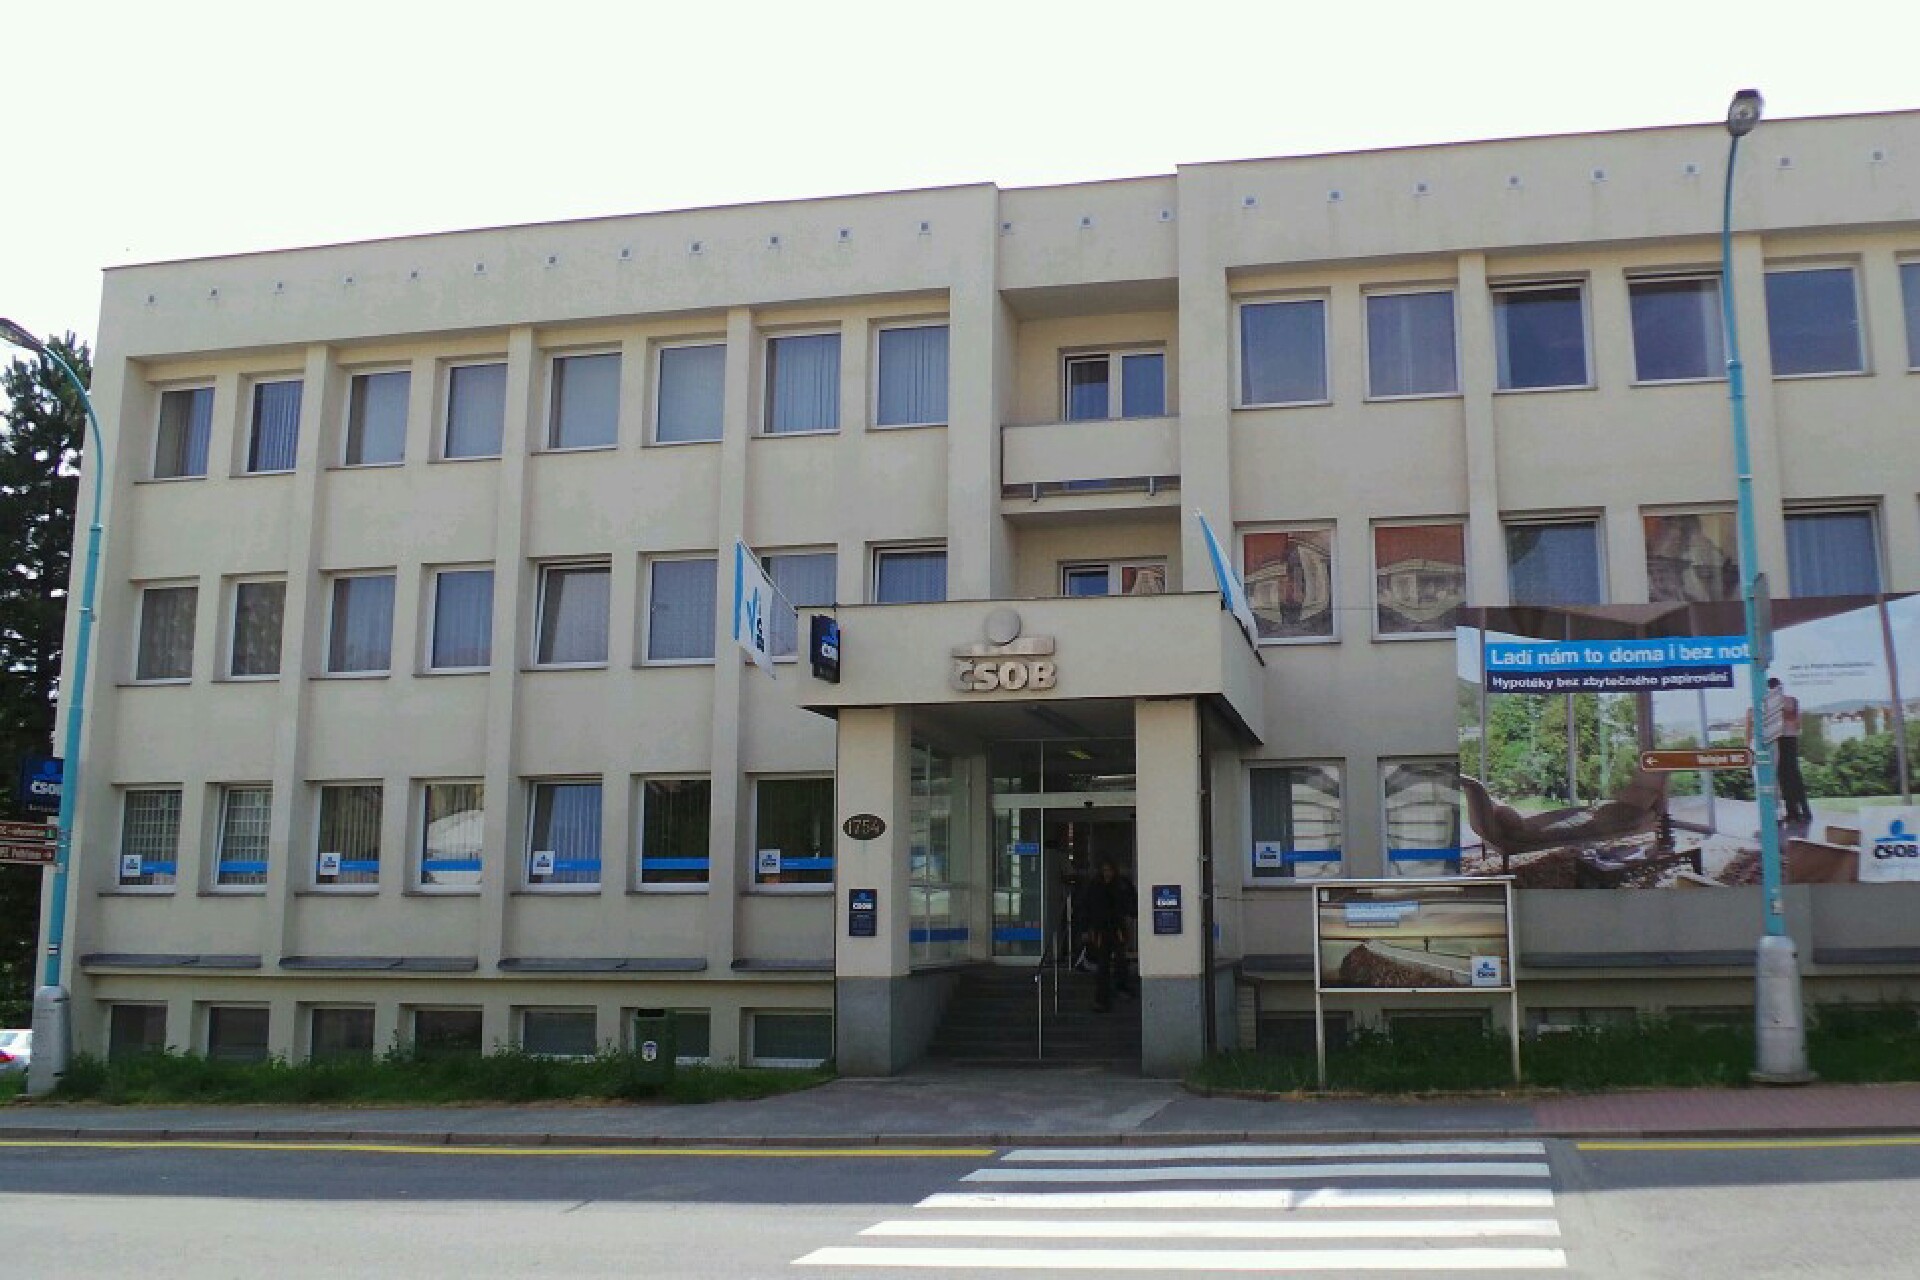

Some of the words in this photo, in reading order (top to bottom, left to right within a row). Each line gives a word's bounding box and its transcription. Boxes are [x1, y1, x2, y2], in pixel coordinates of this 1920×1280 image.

[1538, 647, 1579, 664] nám
[1584, 647, 1604, 663] to
[1609, 645, 1664, 662] doma
[1668, 644, 1675, 660] i
[1680, 644, 1715, 660] bez
[951, 659, 1056, 692] ČSOB
[1556, 675, 1580, 688] bez
